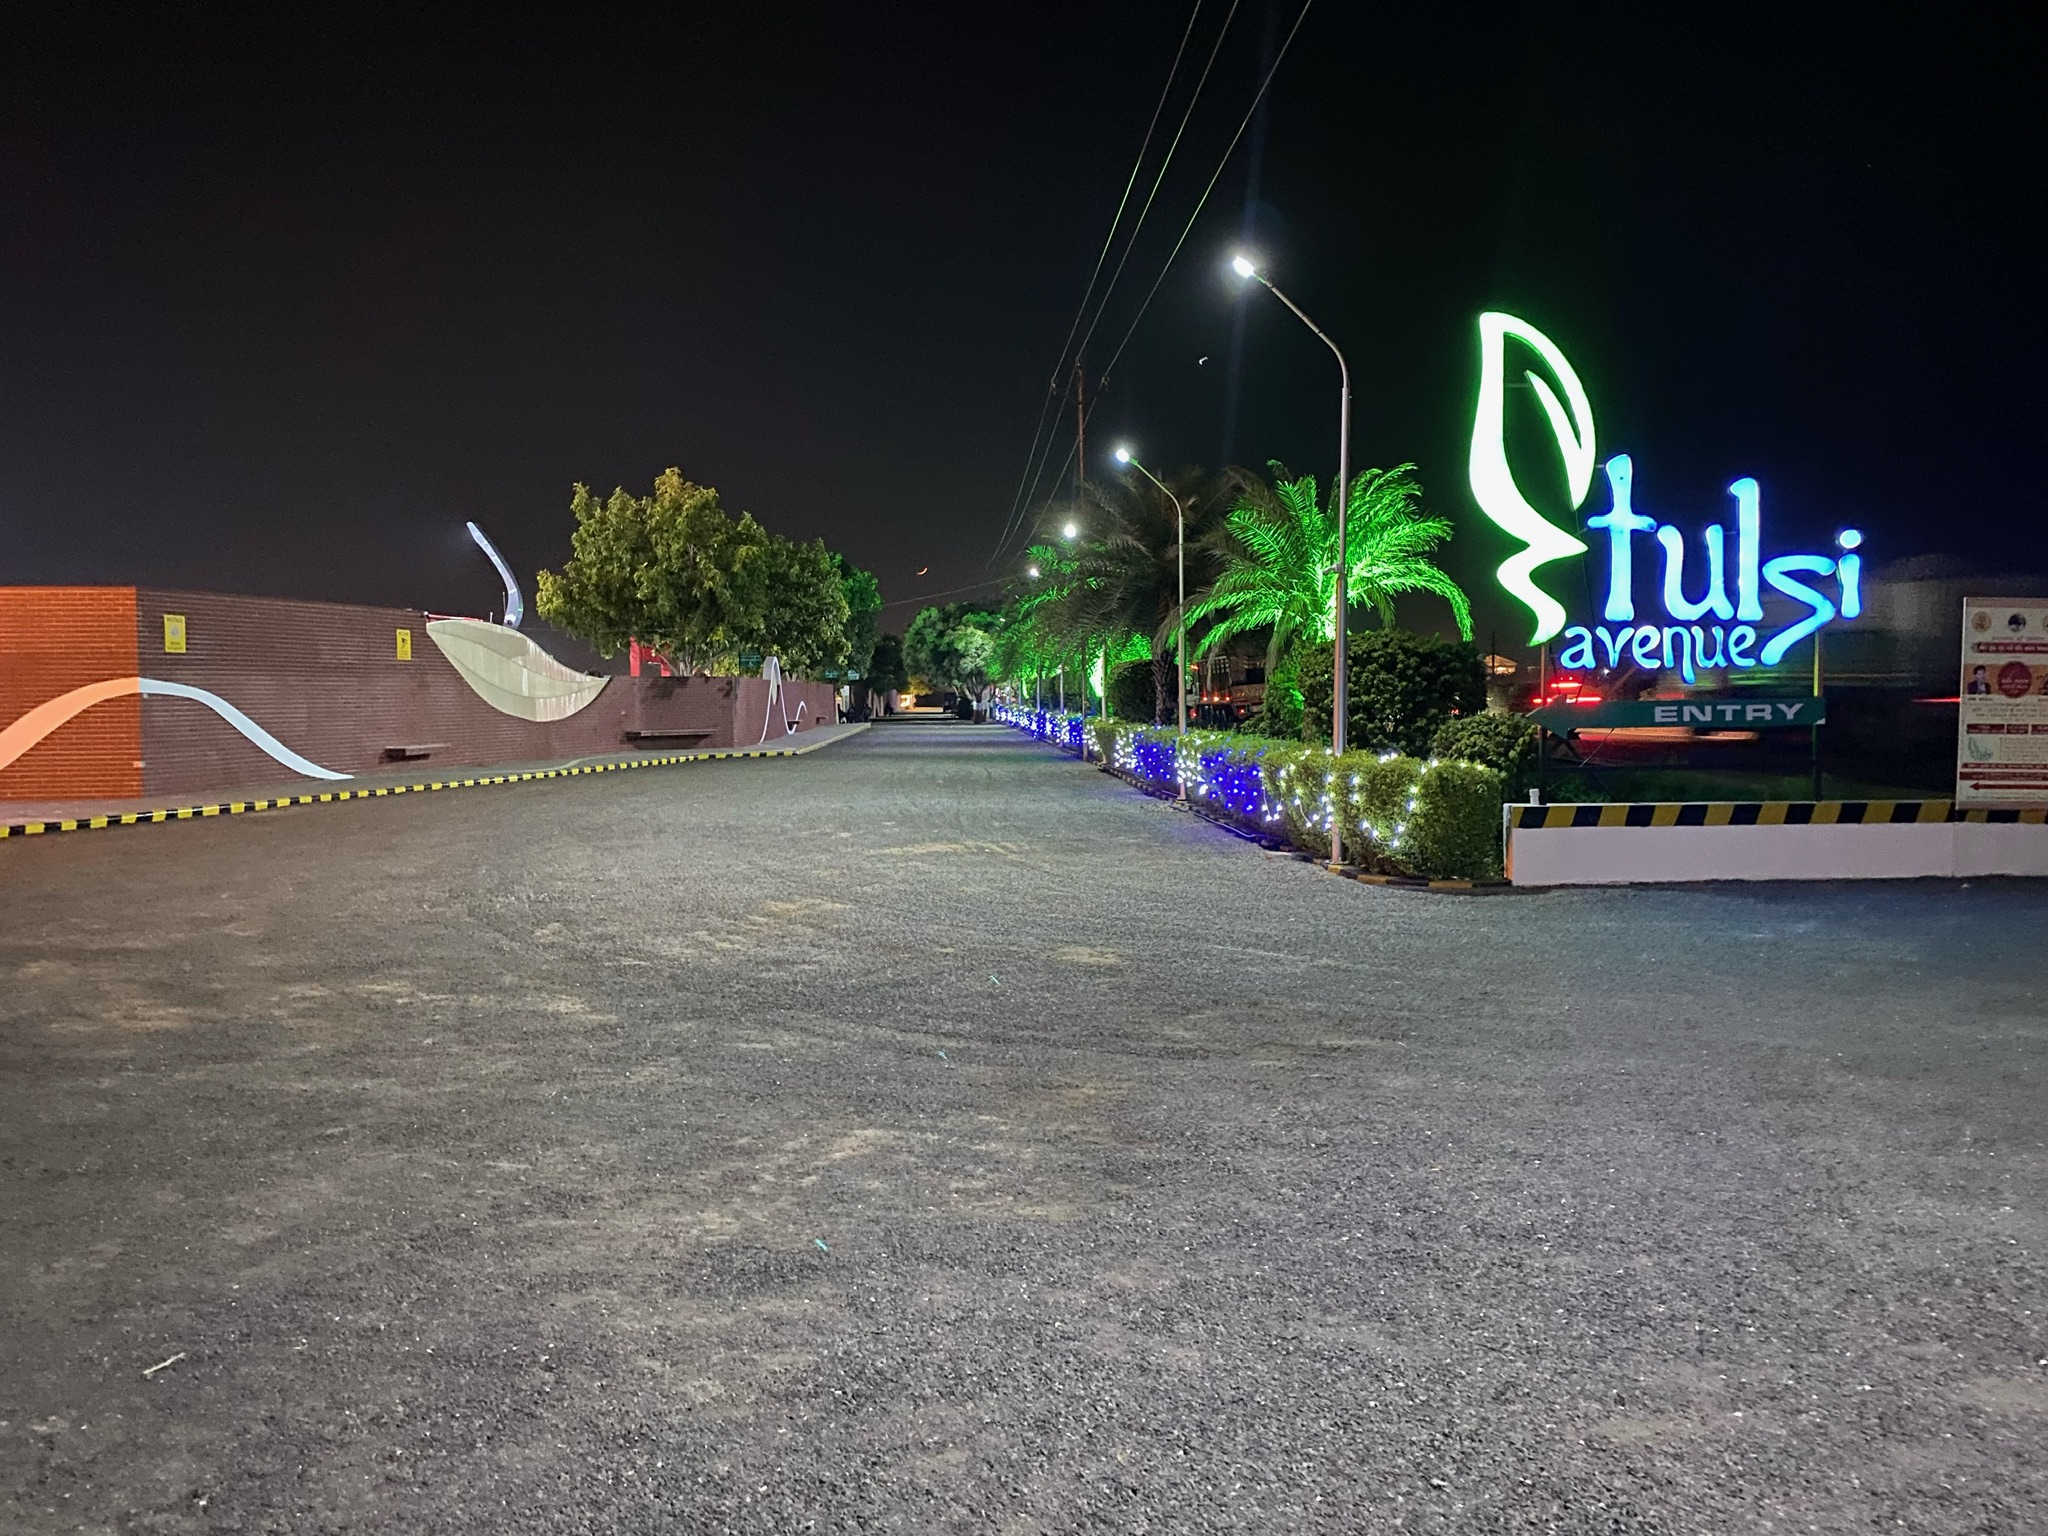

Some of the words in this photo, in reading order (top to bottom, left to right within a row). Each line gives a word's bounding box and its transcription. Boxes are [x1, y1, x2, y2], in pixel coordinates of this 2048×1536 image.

[1587, 454, 1861, 666] tulsi
[1560, 625, 1757, 684] avenue
[1654, 703, 1806, 723] ENTRY
